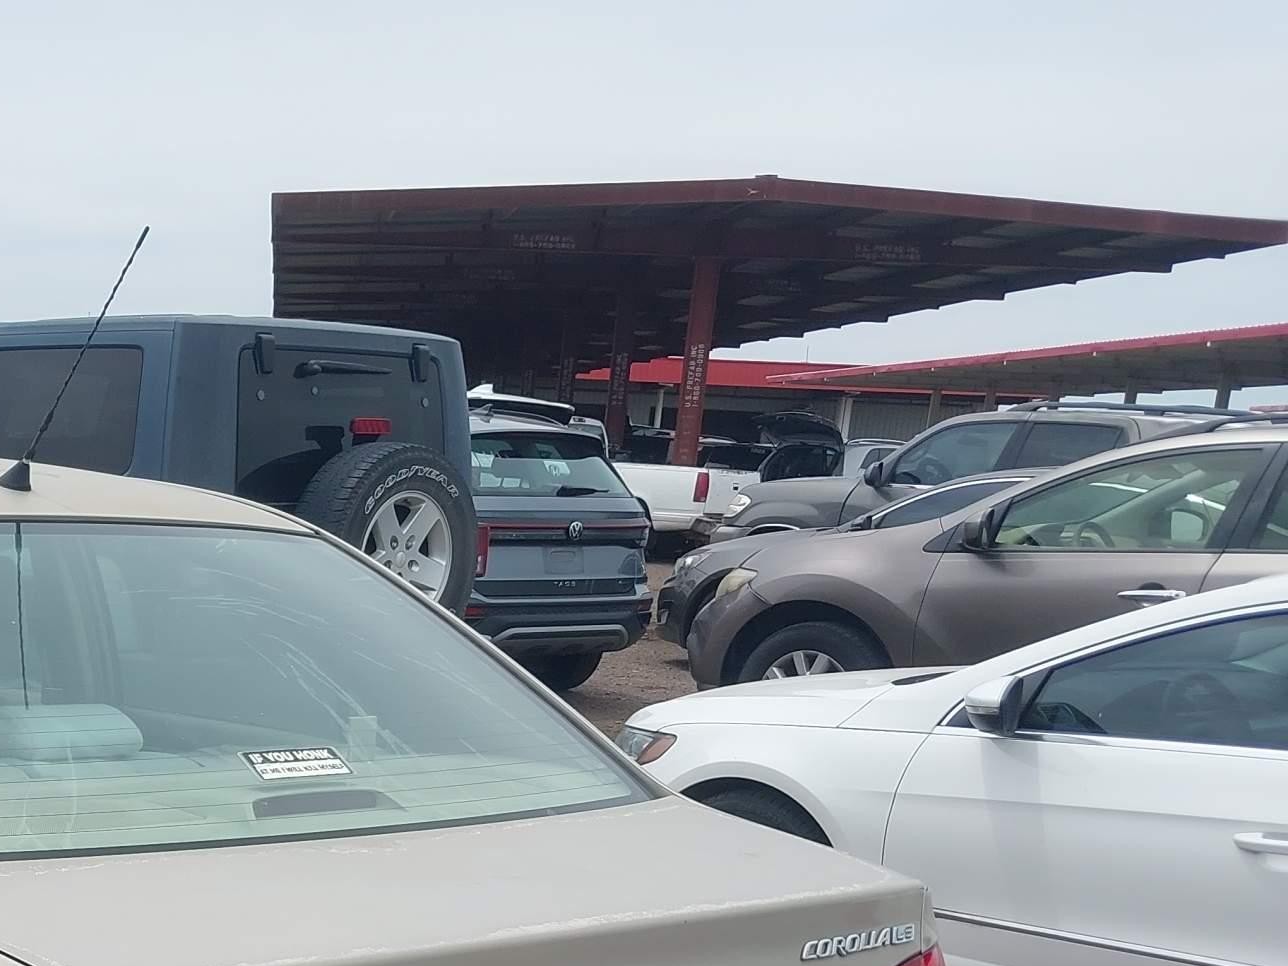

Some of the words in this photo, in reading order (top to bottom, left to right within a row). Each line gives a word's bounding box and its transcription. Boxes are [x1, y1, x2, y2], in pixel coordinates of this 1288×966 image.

[364, 465, 459, 514] GOODYEAR
[248, 753, 264, 764] IF
[263, 751, 294, 762] YOU
[294, 749, 334, 760] HONK
[801, 927, 891, 960] COROLLA
[893, 924, 915, 944] LE
